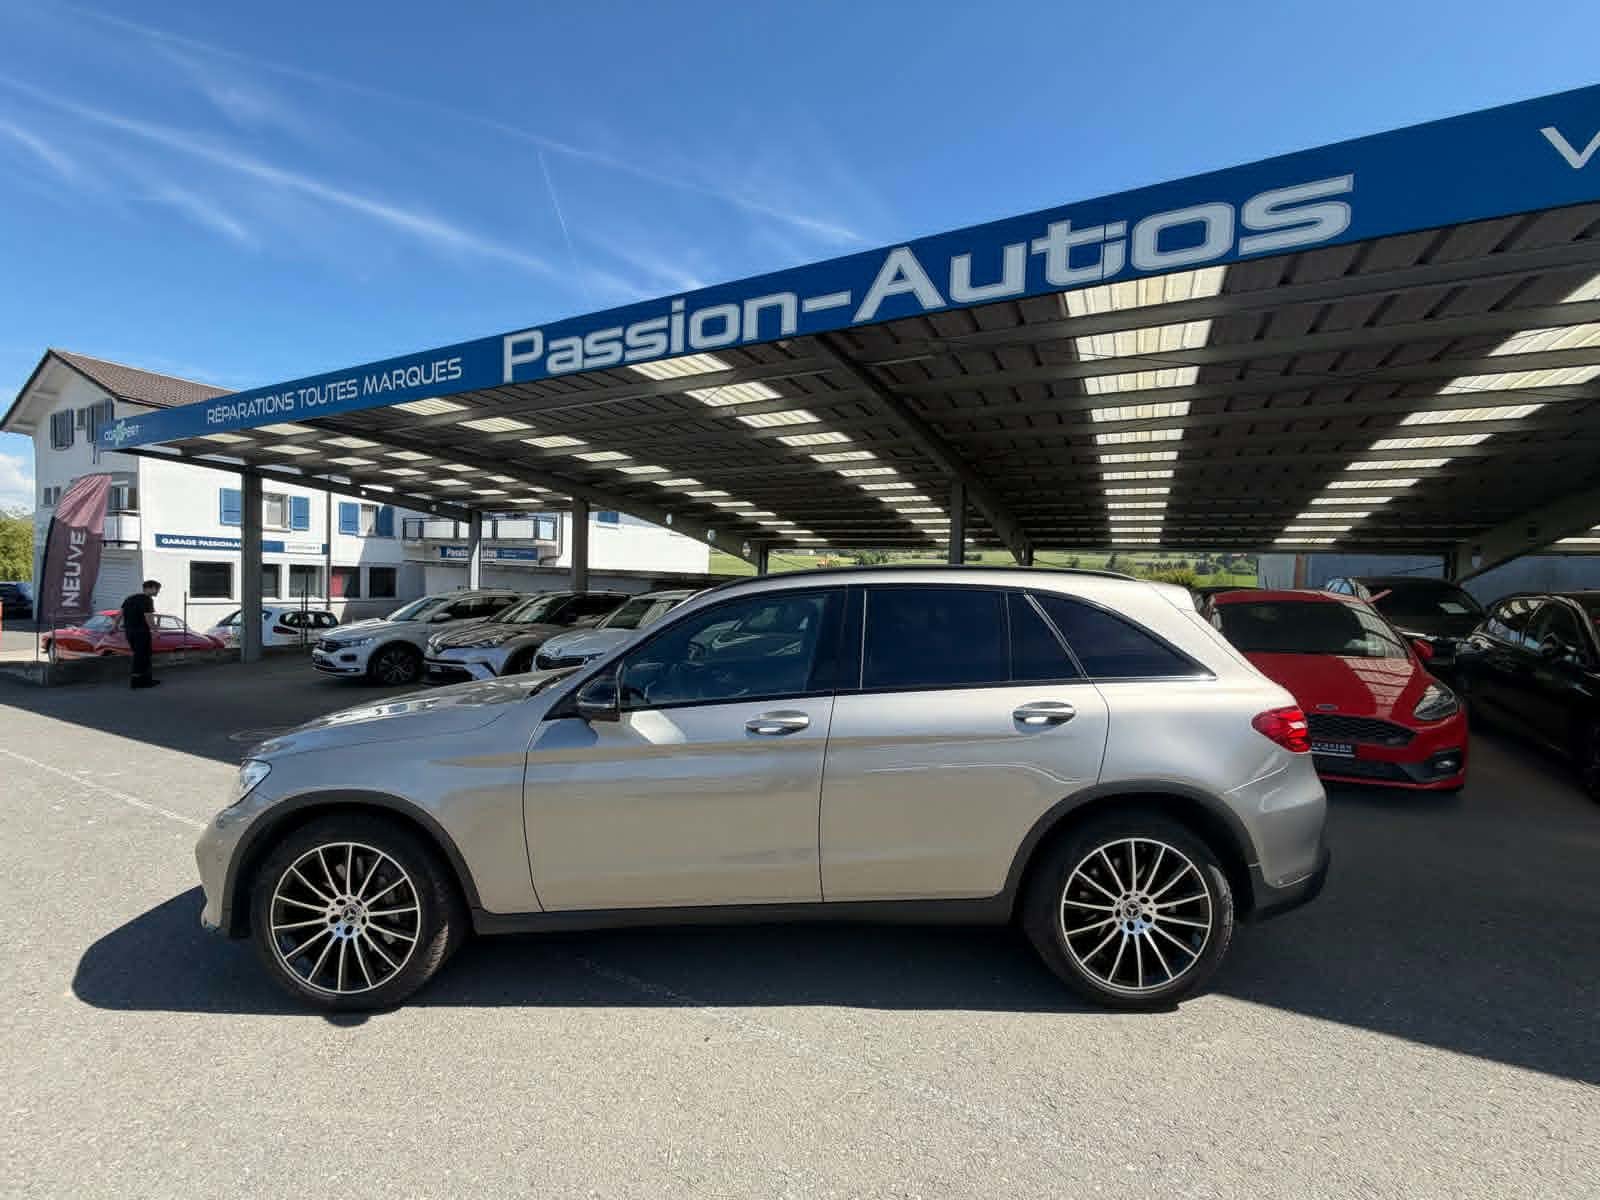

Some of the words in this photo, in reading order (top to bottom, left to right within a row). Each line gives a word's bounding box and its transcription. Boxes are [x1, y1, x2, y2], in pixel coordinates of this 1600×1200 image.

[502, 173, 1355, 383] Passion-Autos
[207, 391, 295, 425] RÉPARATIONS
[297, 379, 359, 409] TOUTES
[362, 357, 463, 396] MARQUES
[61, 530, 87, 607] NEUVE
[162, 538, 197, 546] GARAGE
